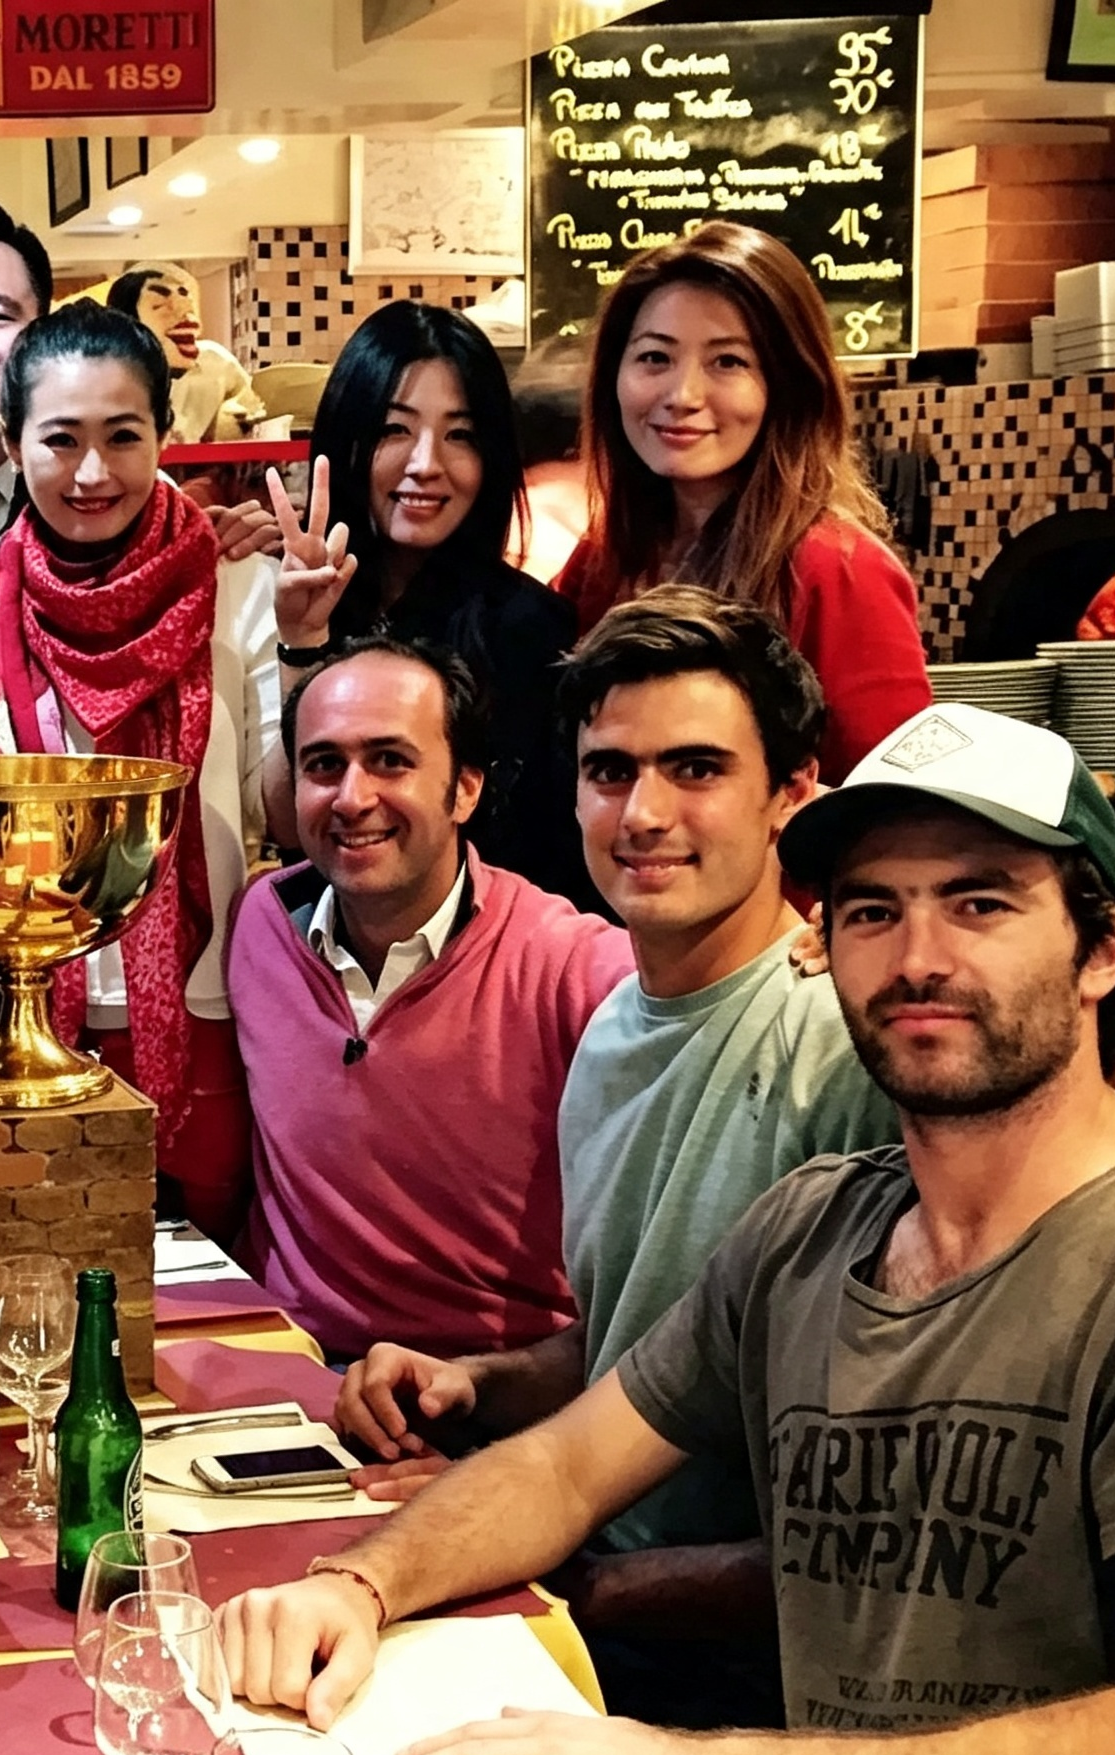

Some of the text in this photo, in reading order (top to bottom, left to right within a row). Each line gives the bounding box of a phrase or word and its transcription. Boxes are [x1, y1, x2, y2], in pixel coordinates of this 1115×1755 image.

[15, 11, 202, 53] MORETTI
[30, 63, 182, 91] DAL 1859
